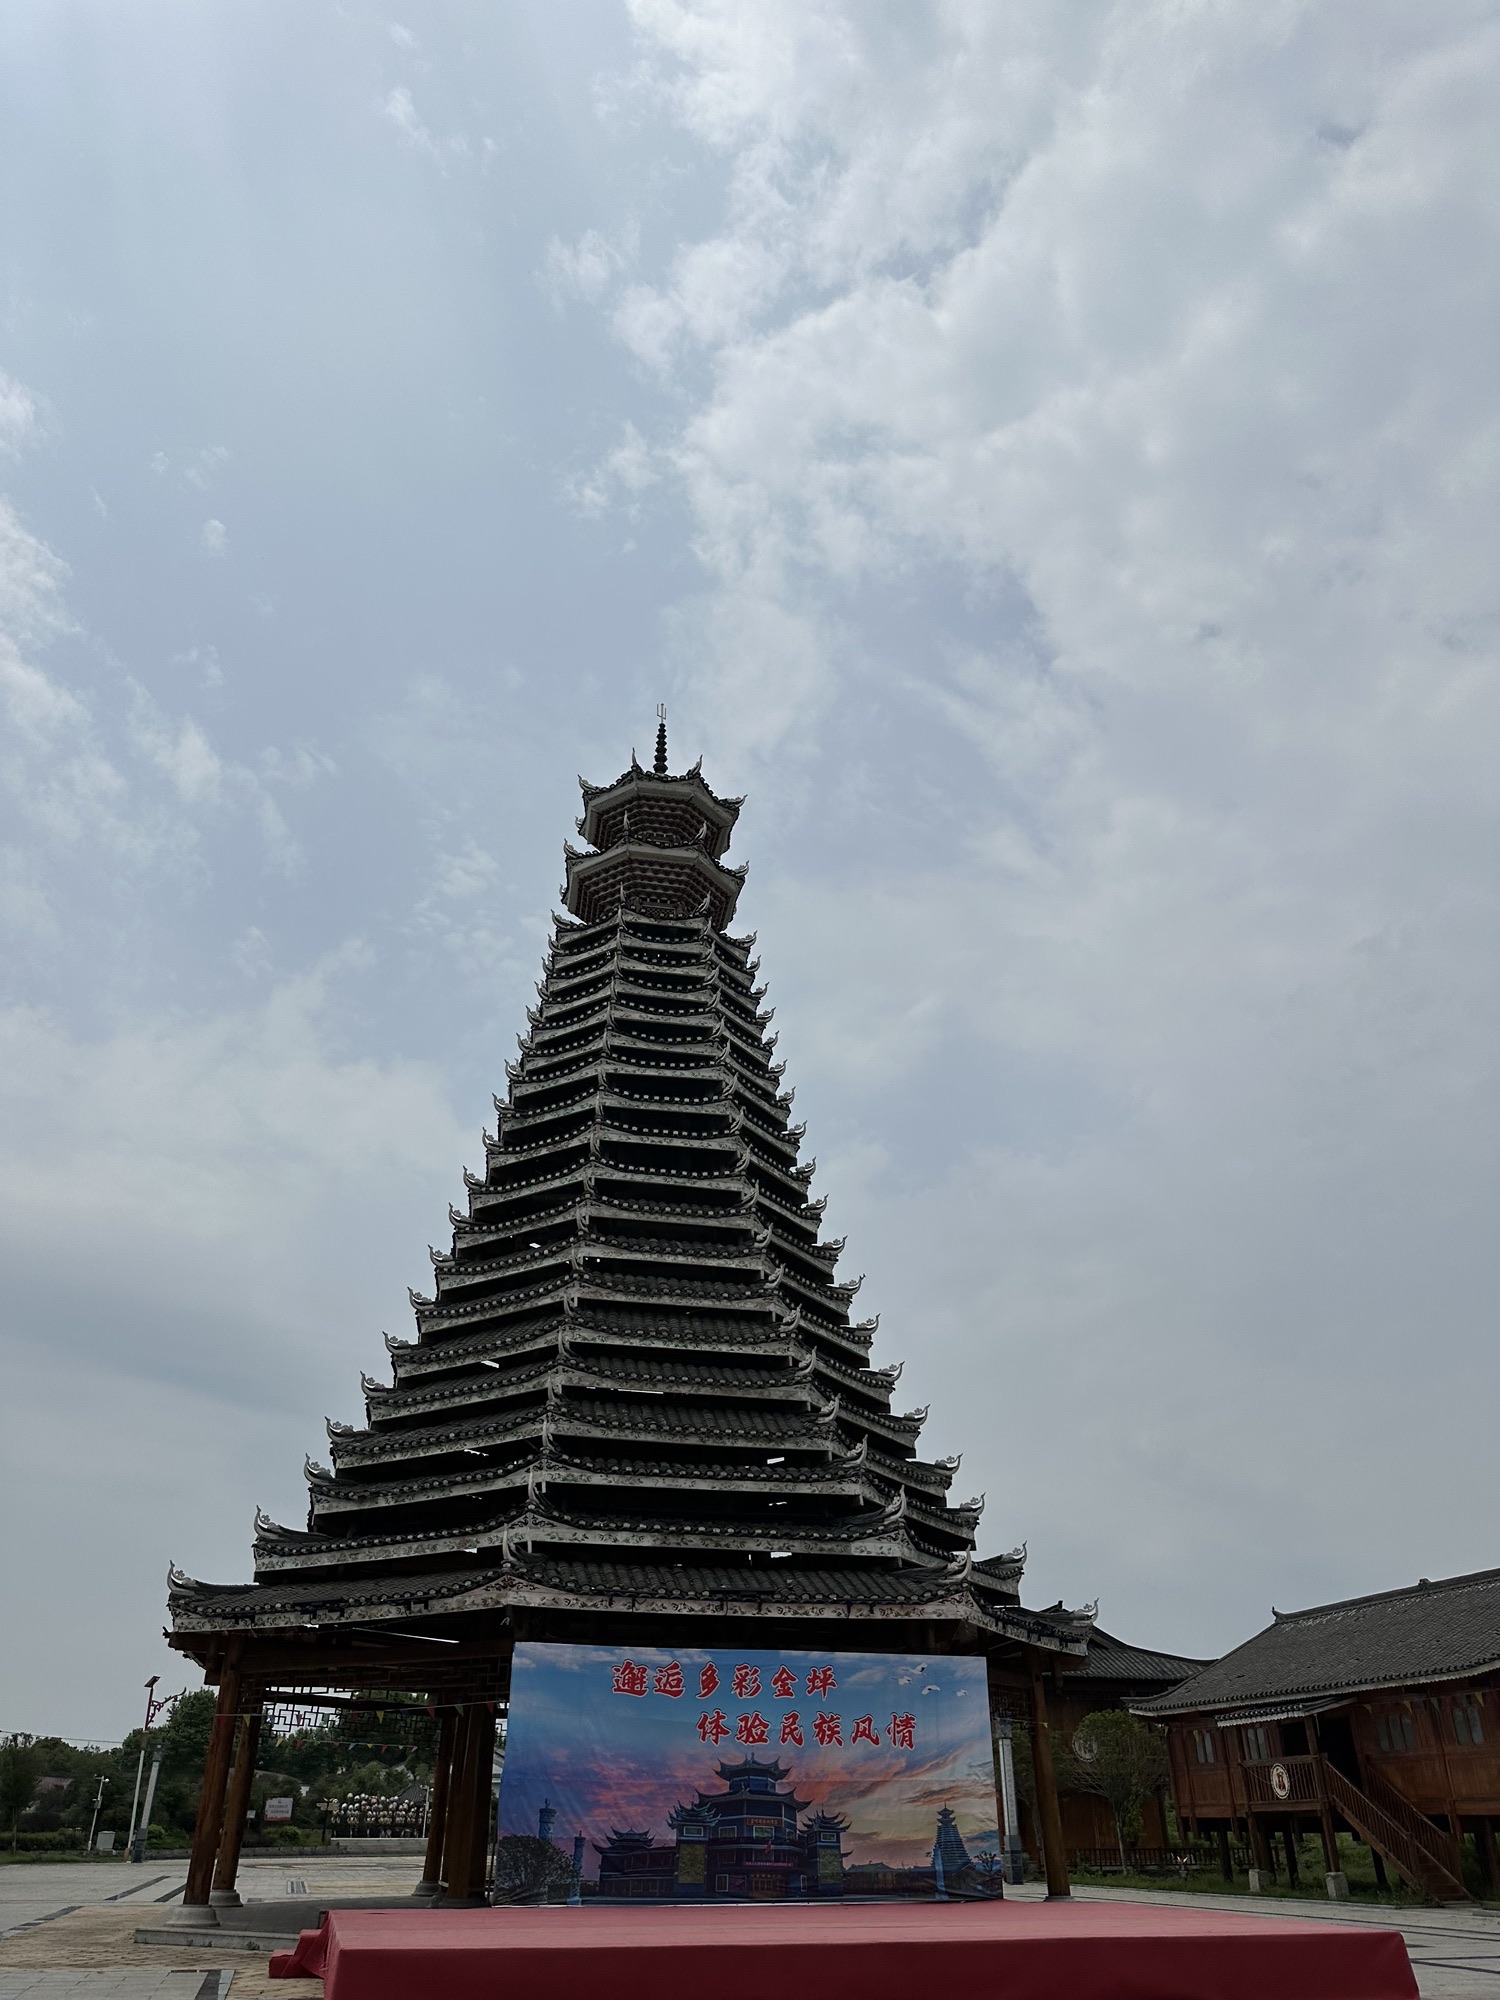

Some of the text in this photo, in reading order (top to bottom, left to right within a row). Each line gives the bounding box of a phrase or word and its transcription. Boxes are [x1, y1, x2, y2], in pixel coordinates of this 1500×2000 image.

[612, 1659, 838, 1701] 邂逅多彩金坪
[696, 1708, 917, 1750] 体验民族风情
